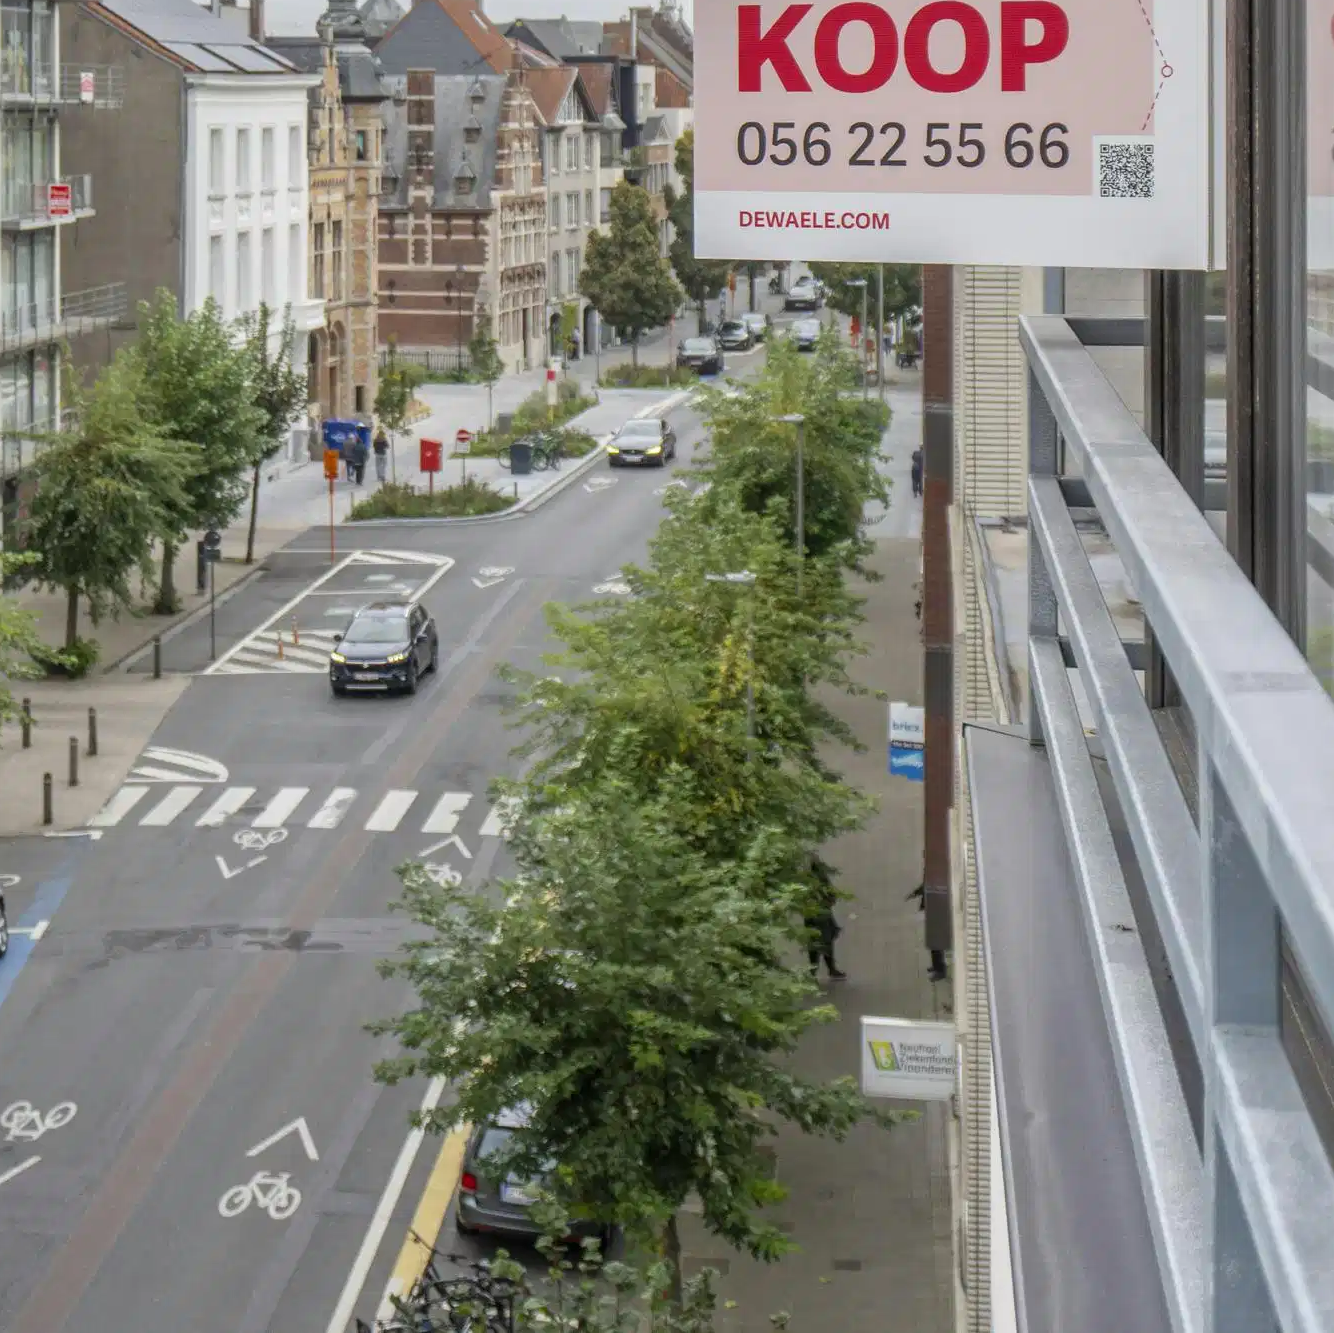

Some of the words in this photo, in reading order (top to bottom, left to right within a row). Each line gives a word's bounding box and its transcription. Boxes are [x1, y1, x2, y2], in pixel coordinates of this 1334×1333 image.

[737, 0, 1069, 94] KOOP
[737, 121, 831, 167] 056
[848, 121, 907, 167] 22
[923, 122, 986, 168] 55
[1004, 122, 1070, 169] 66
[738, 210, 891, 231] DEWAELE.COM
[899, 1053, 955, 1065] Ziekenfond
